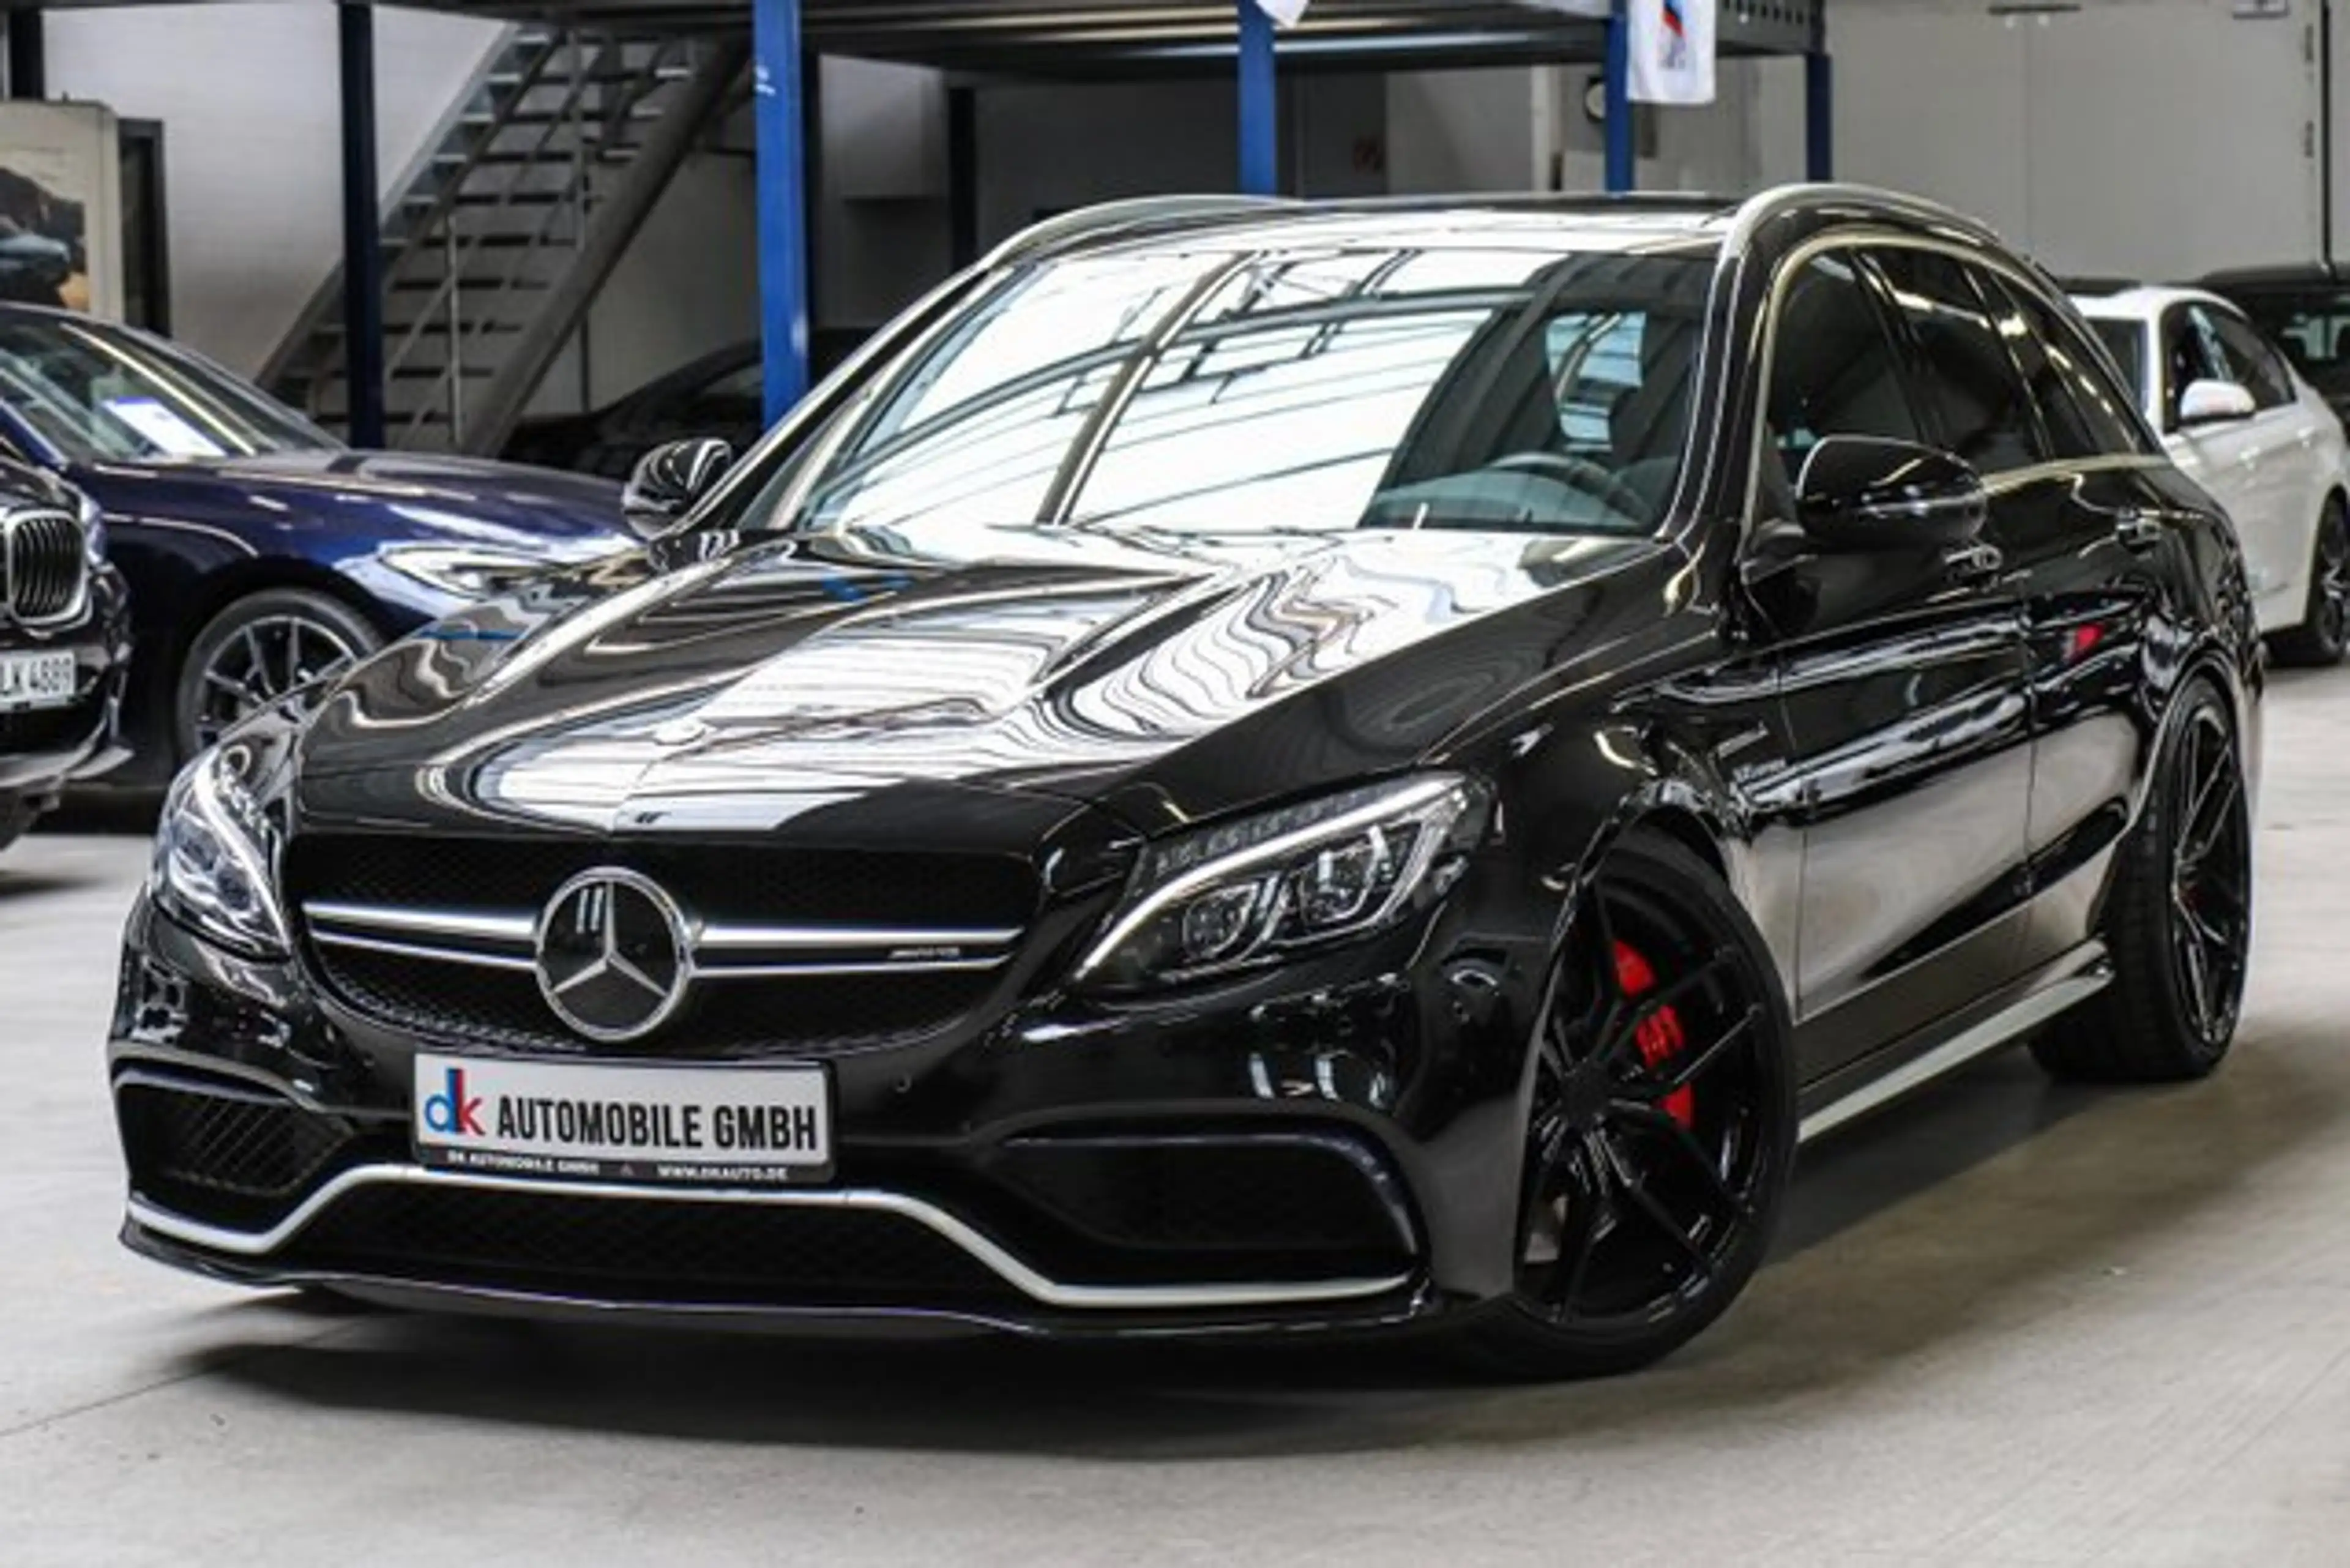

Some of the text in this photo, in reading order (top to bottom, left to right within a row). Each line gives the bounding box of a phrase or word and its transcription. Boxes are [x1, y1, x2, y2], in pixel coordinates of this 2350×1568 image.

[424, 1068, 818, 1151] dk AUTOMOBILE GMBH
